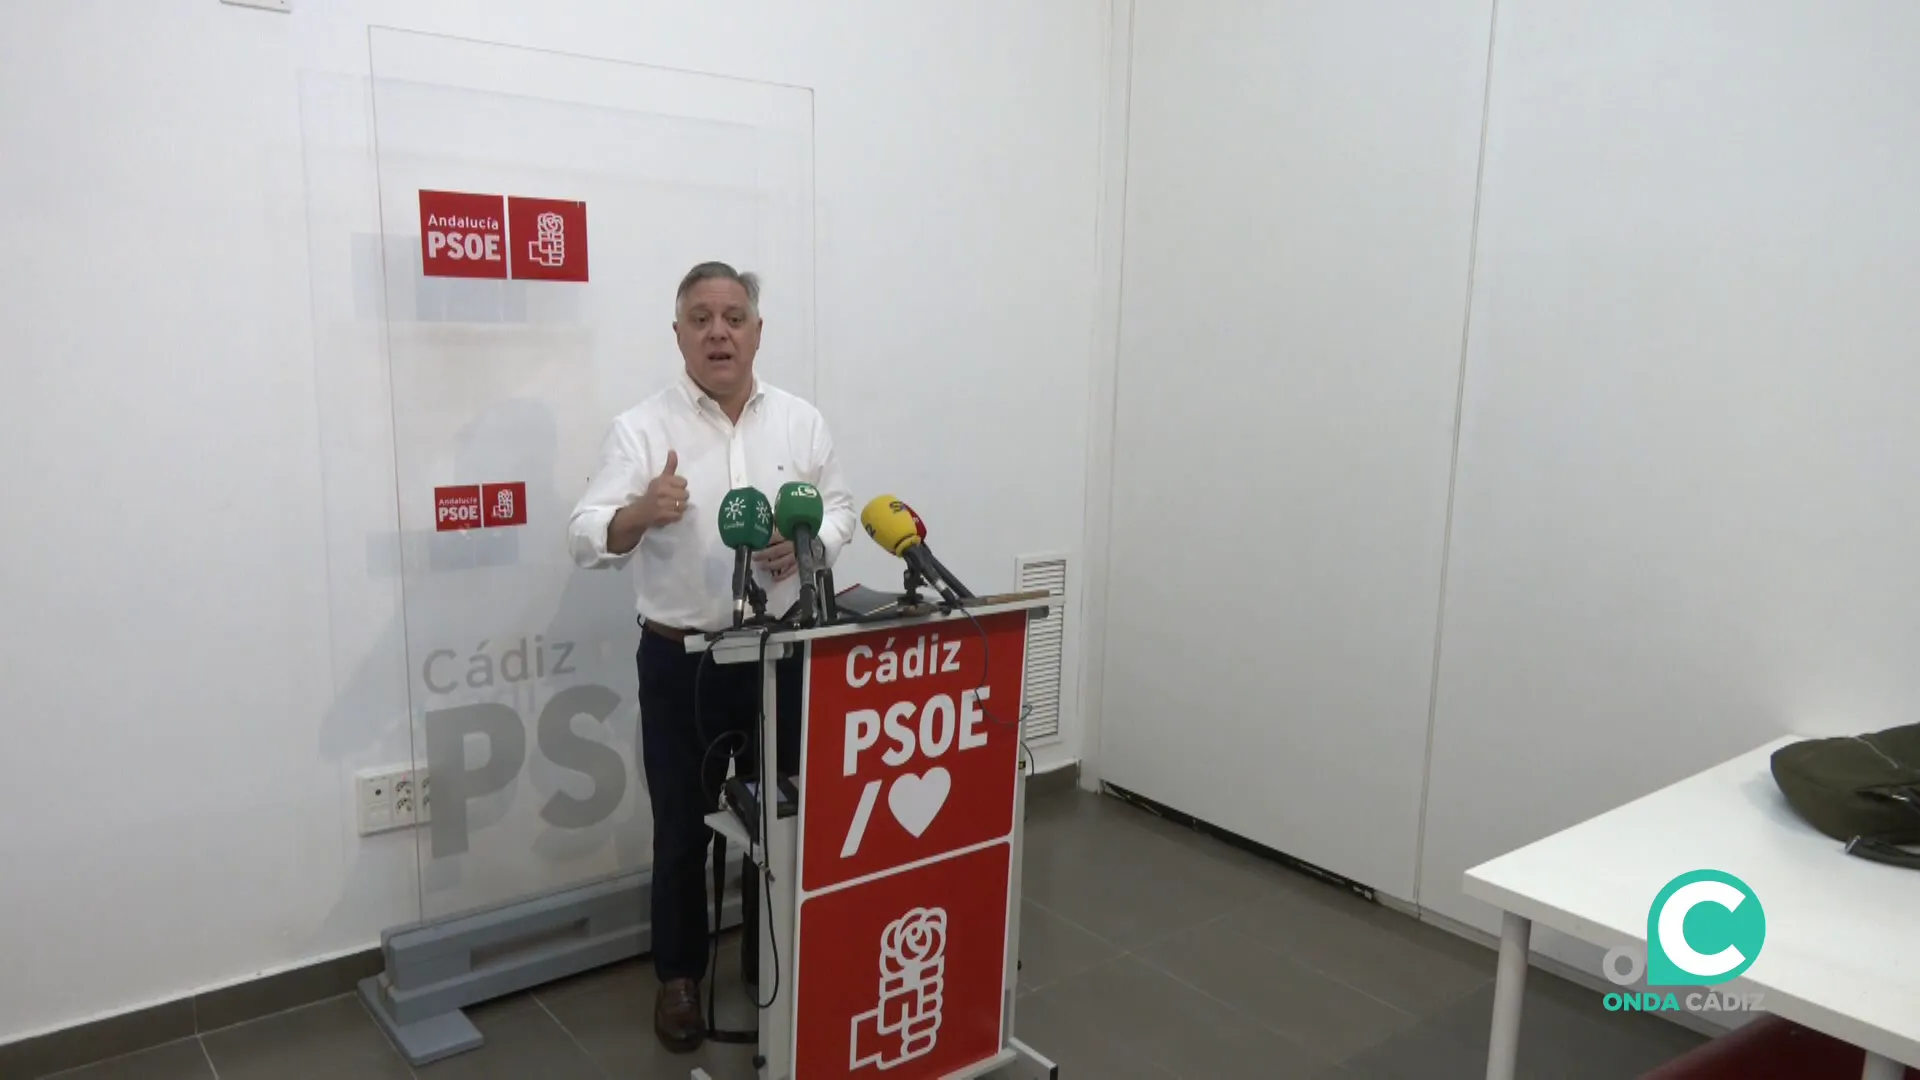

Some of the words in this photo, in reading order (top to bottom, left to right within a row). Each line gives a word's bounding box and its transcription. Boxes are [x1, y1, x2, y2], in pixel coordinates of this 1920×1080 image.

[428, 213, 499, 230] Andalucía
[428, 231, 501, 261] PSOE
[438, 505, 478, 522] PSOE
[422, 635, 577, 694] Cádiz
[845, 633, 962, 688] Cádiz
[843, 685, 991, 777] PSOE
[425, 683, 650, 859] PS
